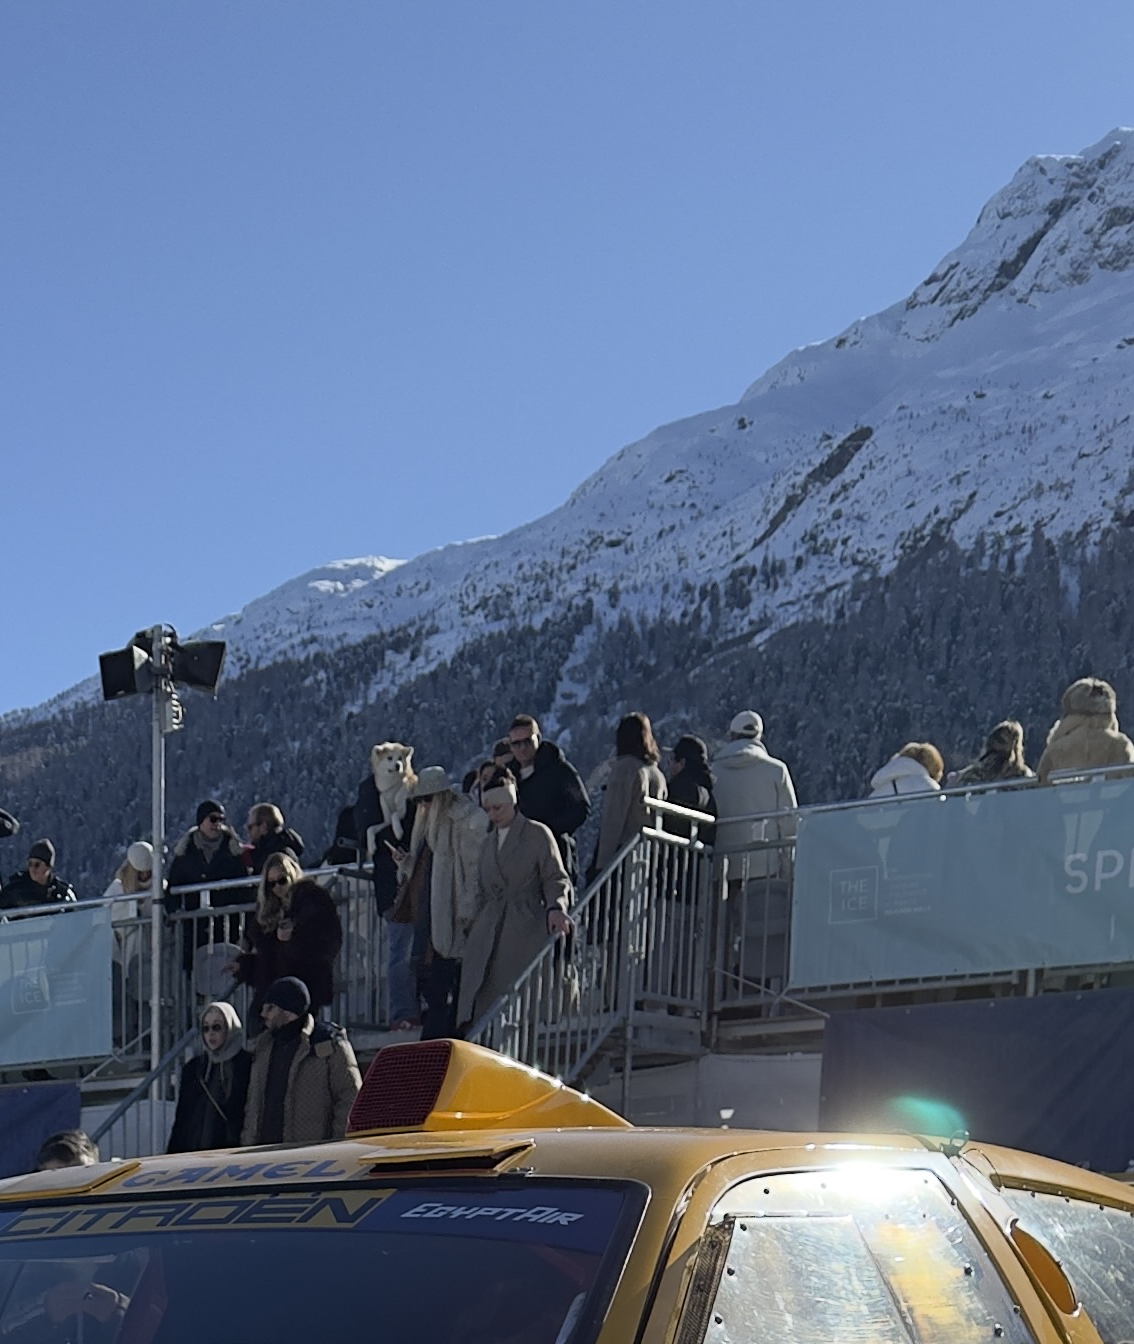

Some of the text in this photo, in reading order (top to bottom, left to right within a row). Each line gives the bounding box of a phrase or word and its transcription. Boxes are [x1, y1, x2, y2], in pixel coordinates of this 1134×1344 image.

[1064, 848, 1134, 894] SP
[839, 878, 869, 894] THE
[841, 896, 868, 912] ICE
[122, 1159, 346, 1188] CAMEL
